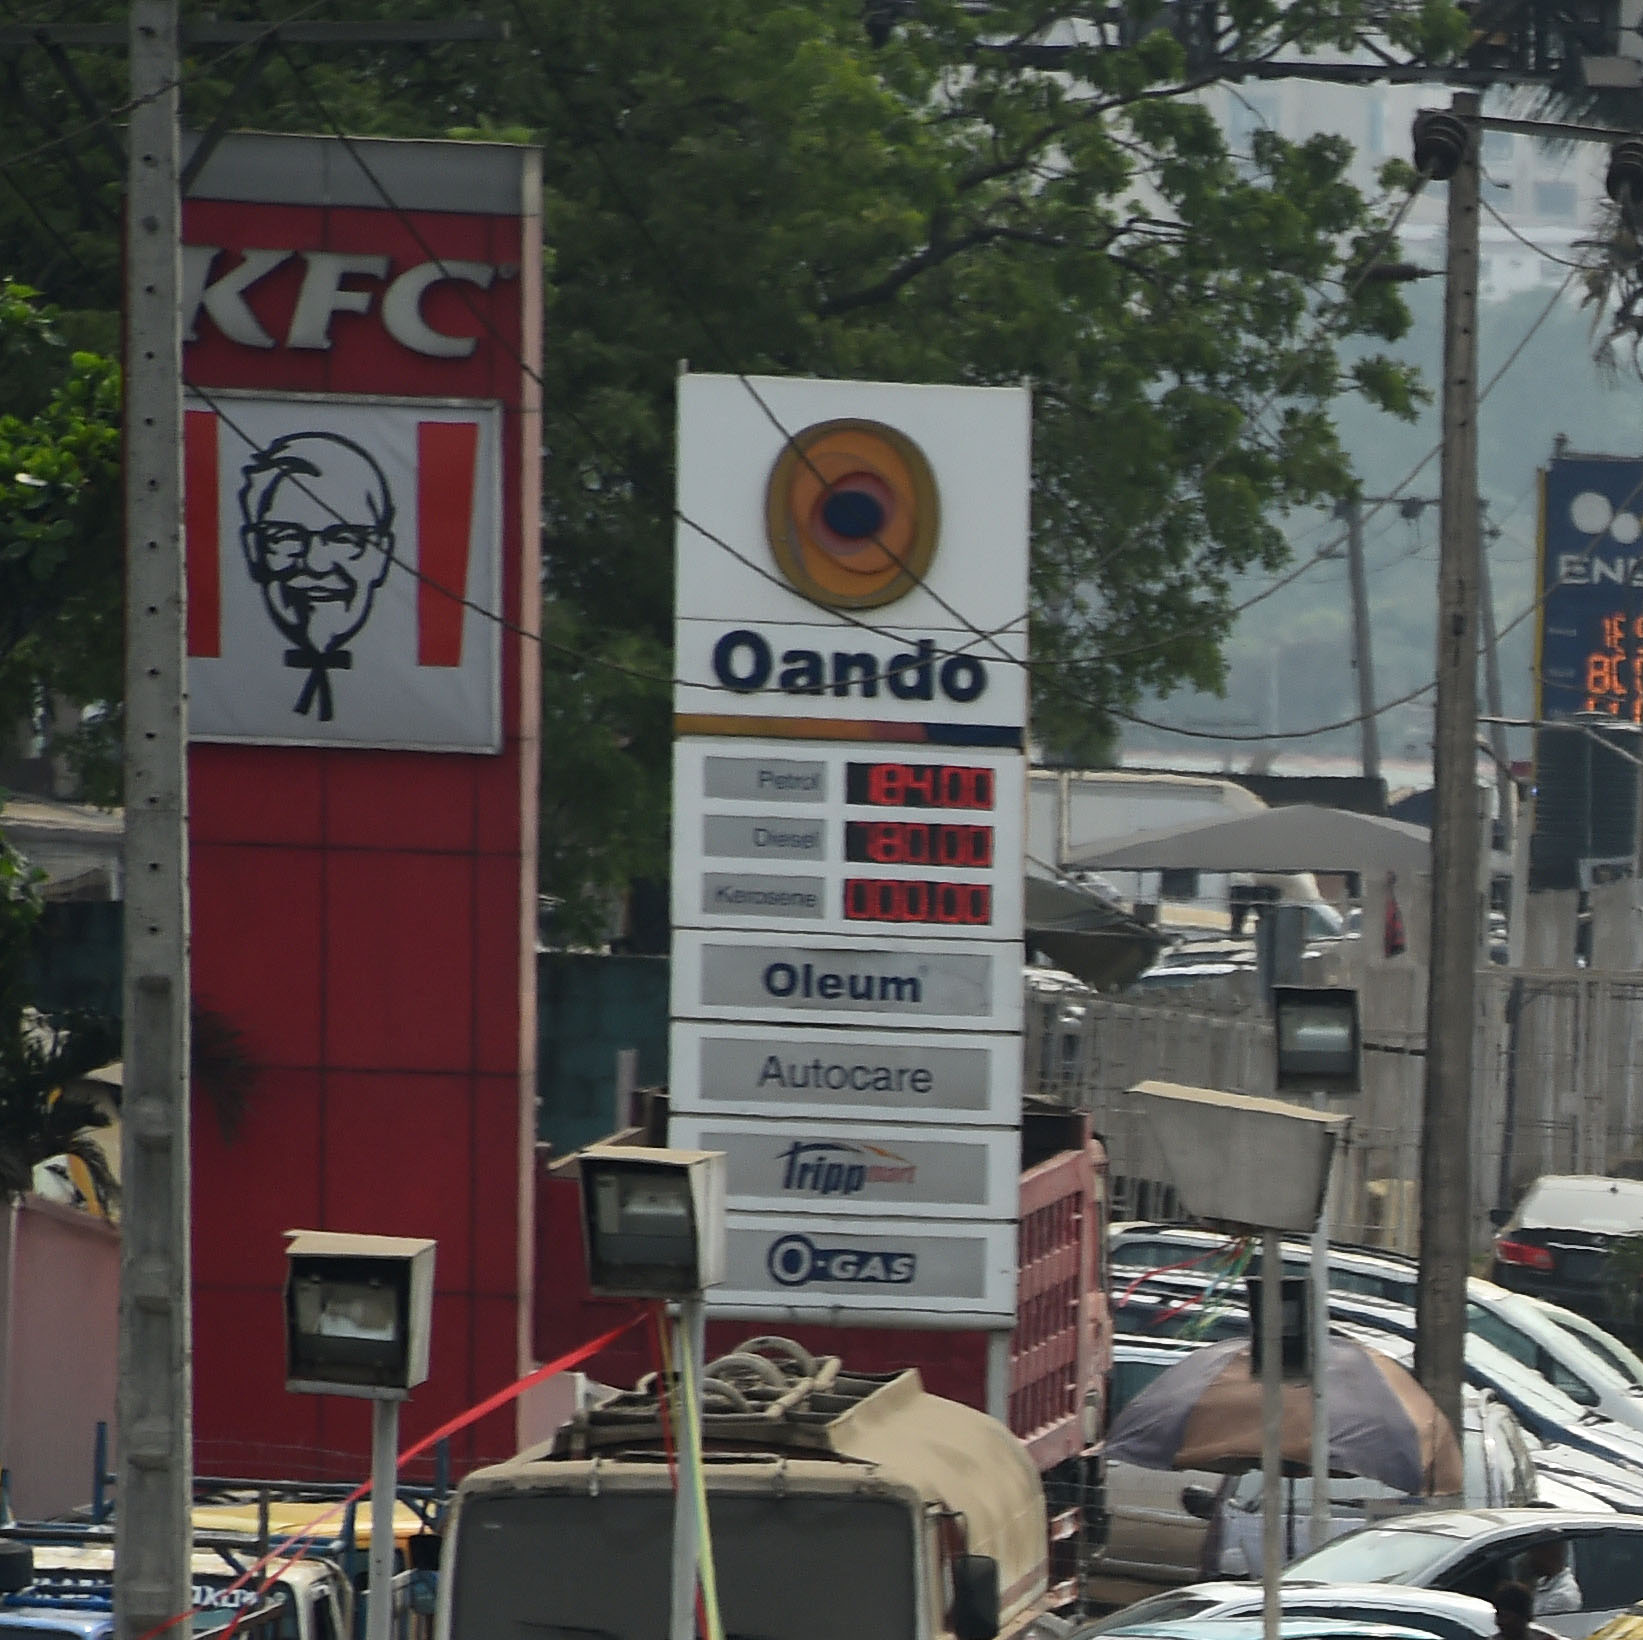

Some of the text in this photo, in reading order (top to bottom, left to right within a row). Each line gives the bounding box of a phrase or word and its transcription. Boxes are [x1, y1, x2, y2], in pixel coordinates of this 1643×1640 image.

[183, 246, 495, 359] KFC
[713, 629, 986, 702] Oando
[758, 769, 821, 791] Petrol
[753, 827, 820, 850] Diesel
[714, 885, 817, 908] Kerosene
[763, 962, 922, 1003] Oleum
[757, 1055, 934, 1094] Autocare
[772, 1239, 915, 1283] O-GAS
